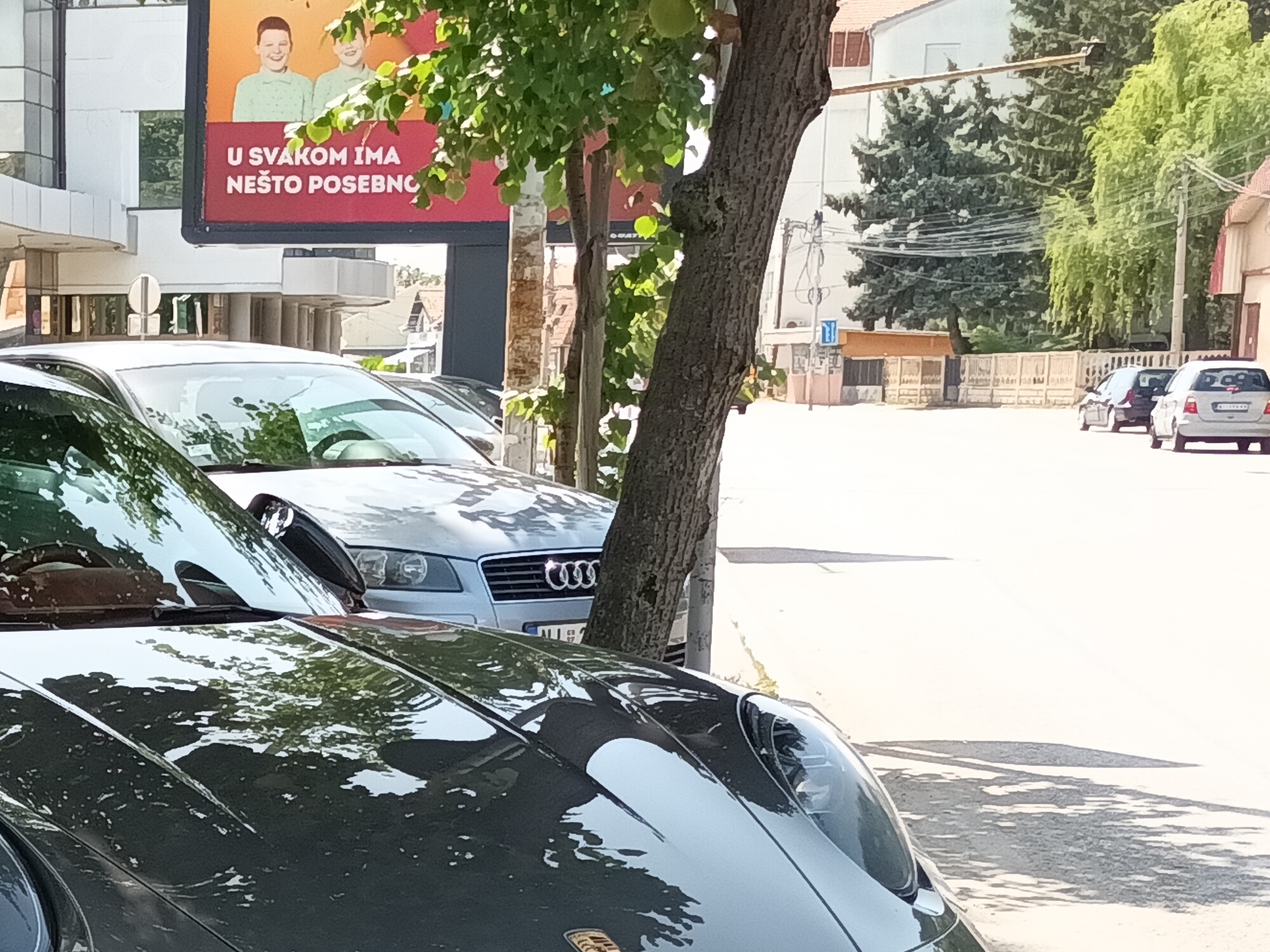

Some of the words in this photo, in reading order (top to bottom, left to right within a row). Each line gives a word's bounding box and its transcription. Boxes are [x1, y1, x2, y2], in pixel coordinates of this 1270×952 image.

[227, 147, 243, 166] U
[248, 146, 348, 166] SVAKOM
[353, 146, 401, 165] IMA
[226, 170, 303, 194] NEŠTO
